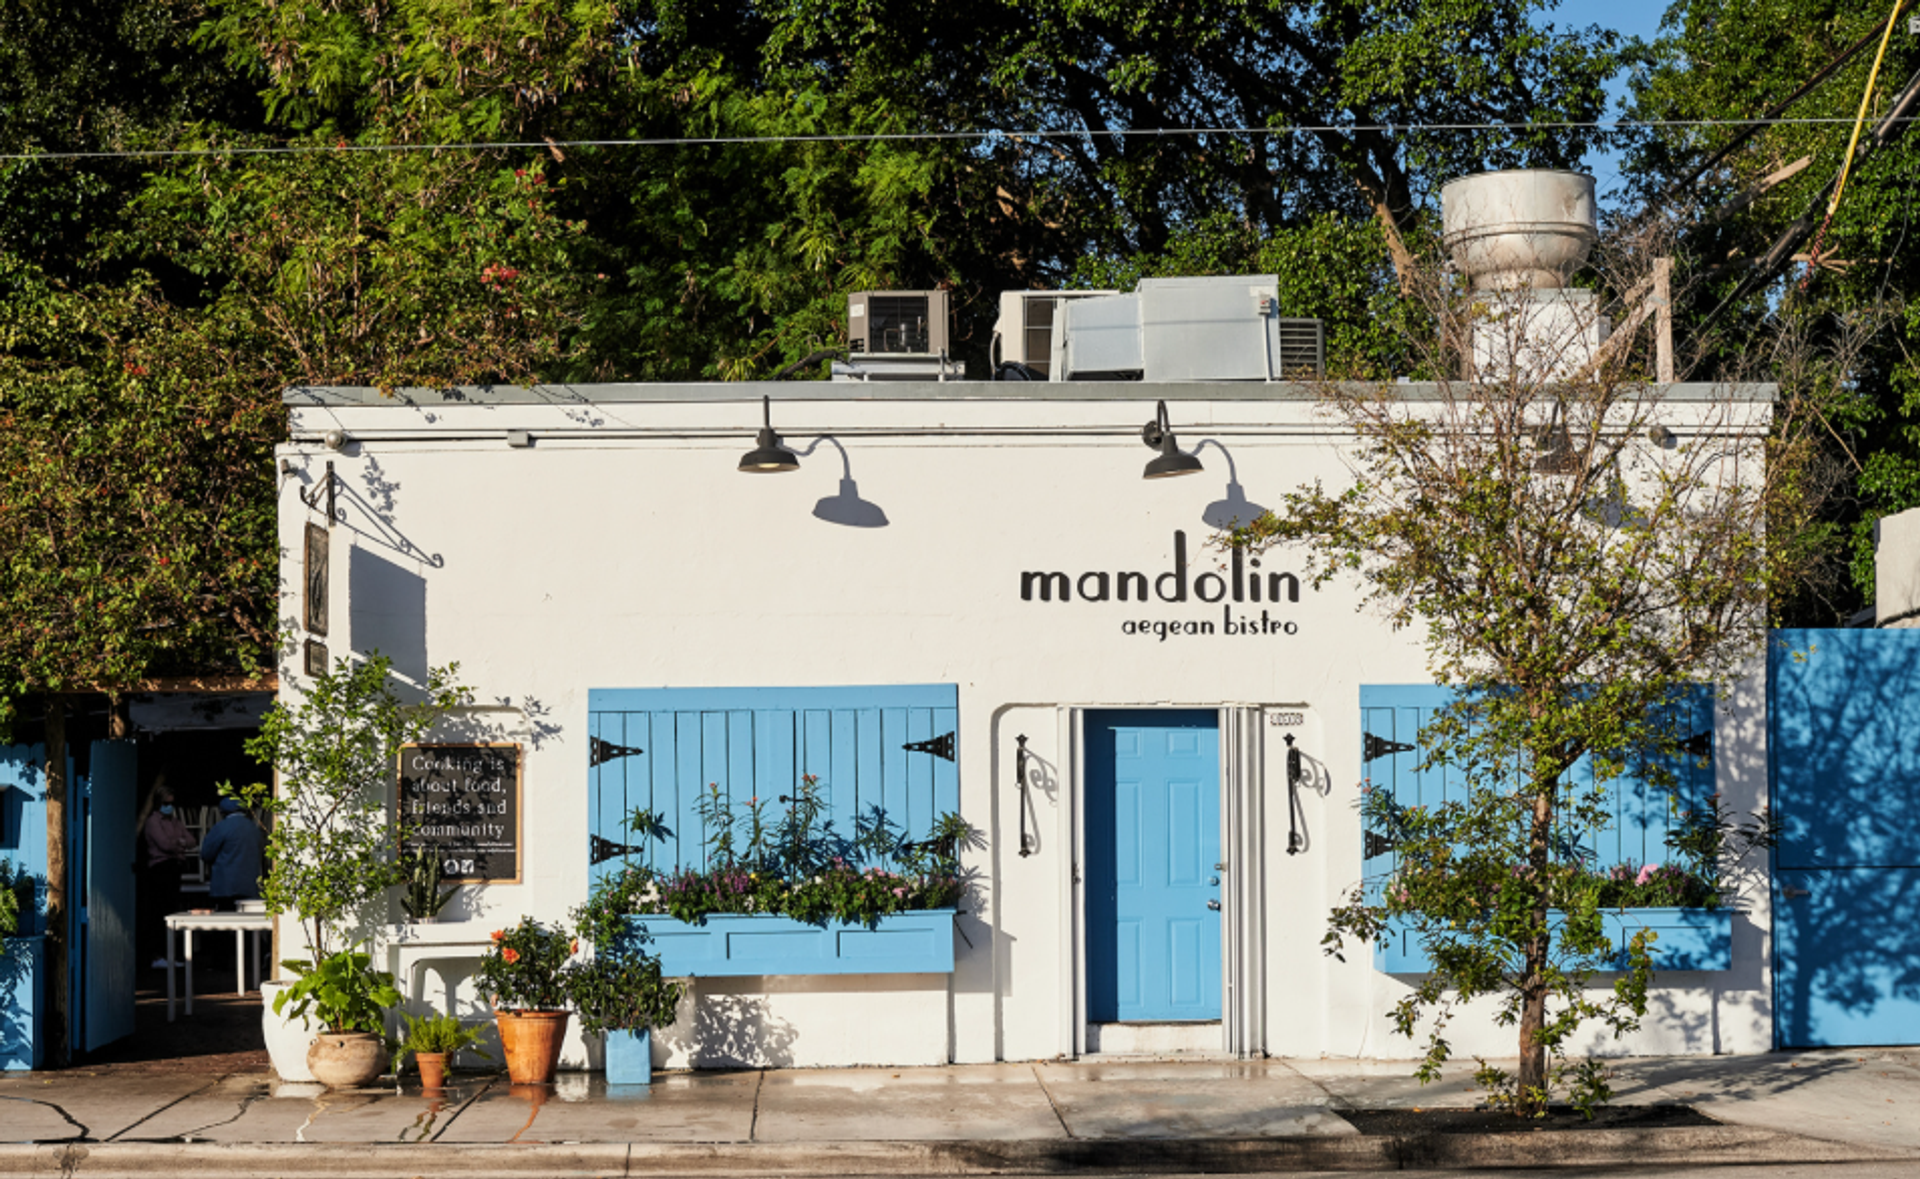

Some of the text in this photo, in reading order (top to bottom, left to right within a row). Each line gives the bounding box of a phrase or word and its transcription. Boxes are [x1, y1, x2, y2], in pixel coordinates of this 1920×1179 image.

[1020, 529, 1300, 603] mandolin
[1121, 604, 1299, 642] aegean bistro
[412, 756, 505, 774] Cooking is
[412, 777, 506, 795] about food,
[477, 800, 507, 814] and
[412, 823, 504, 839] community
